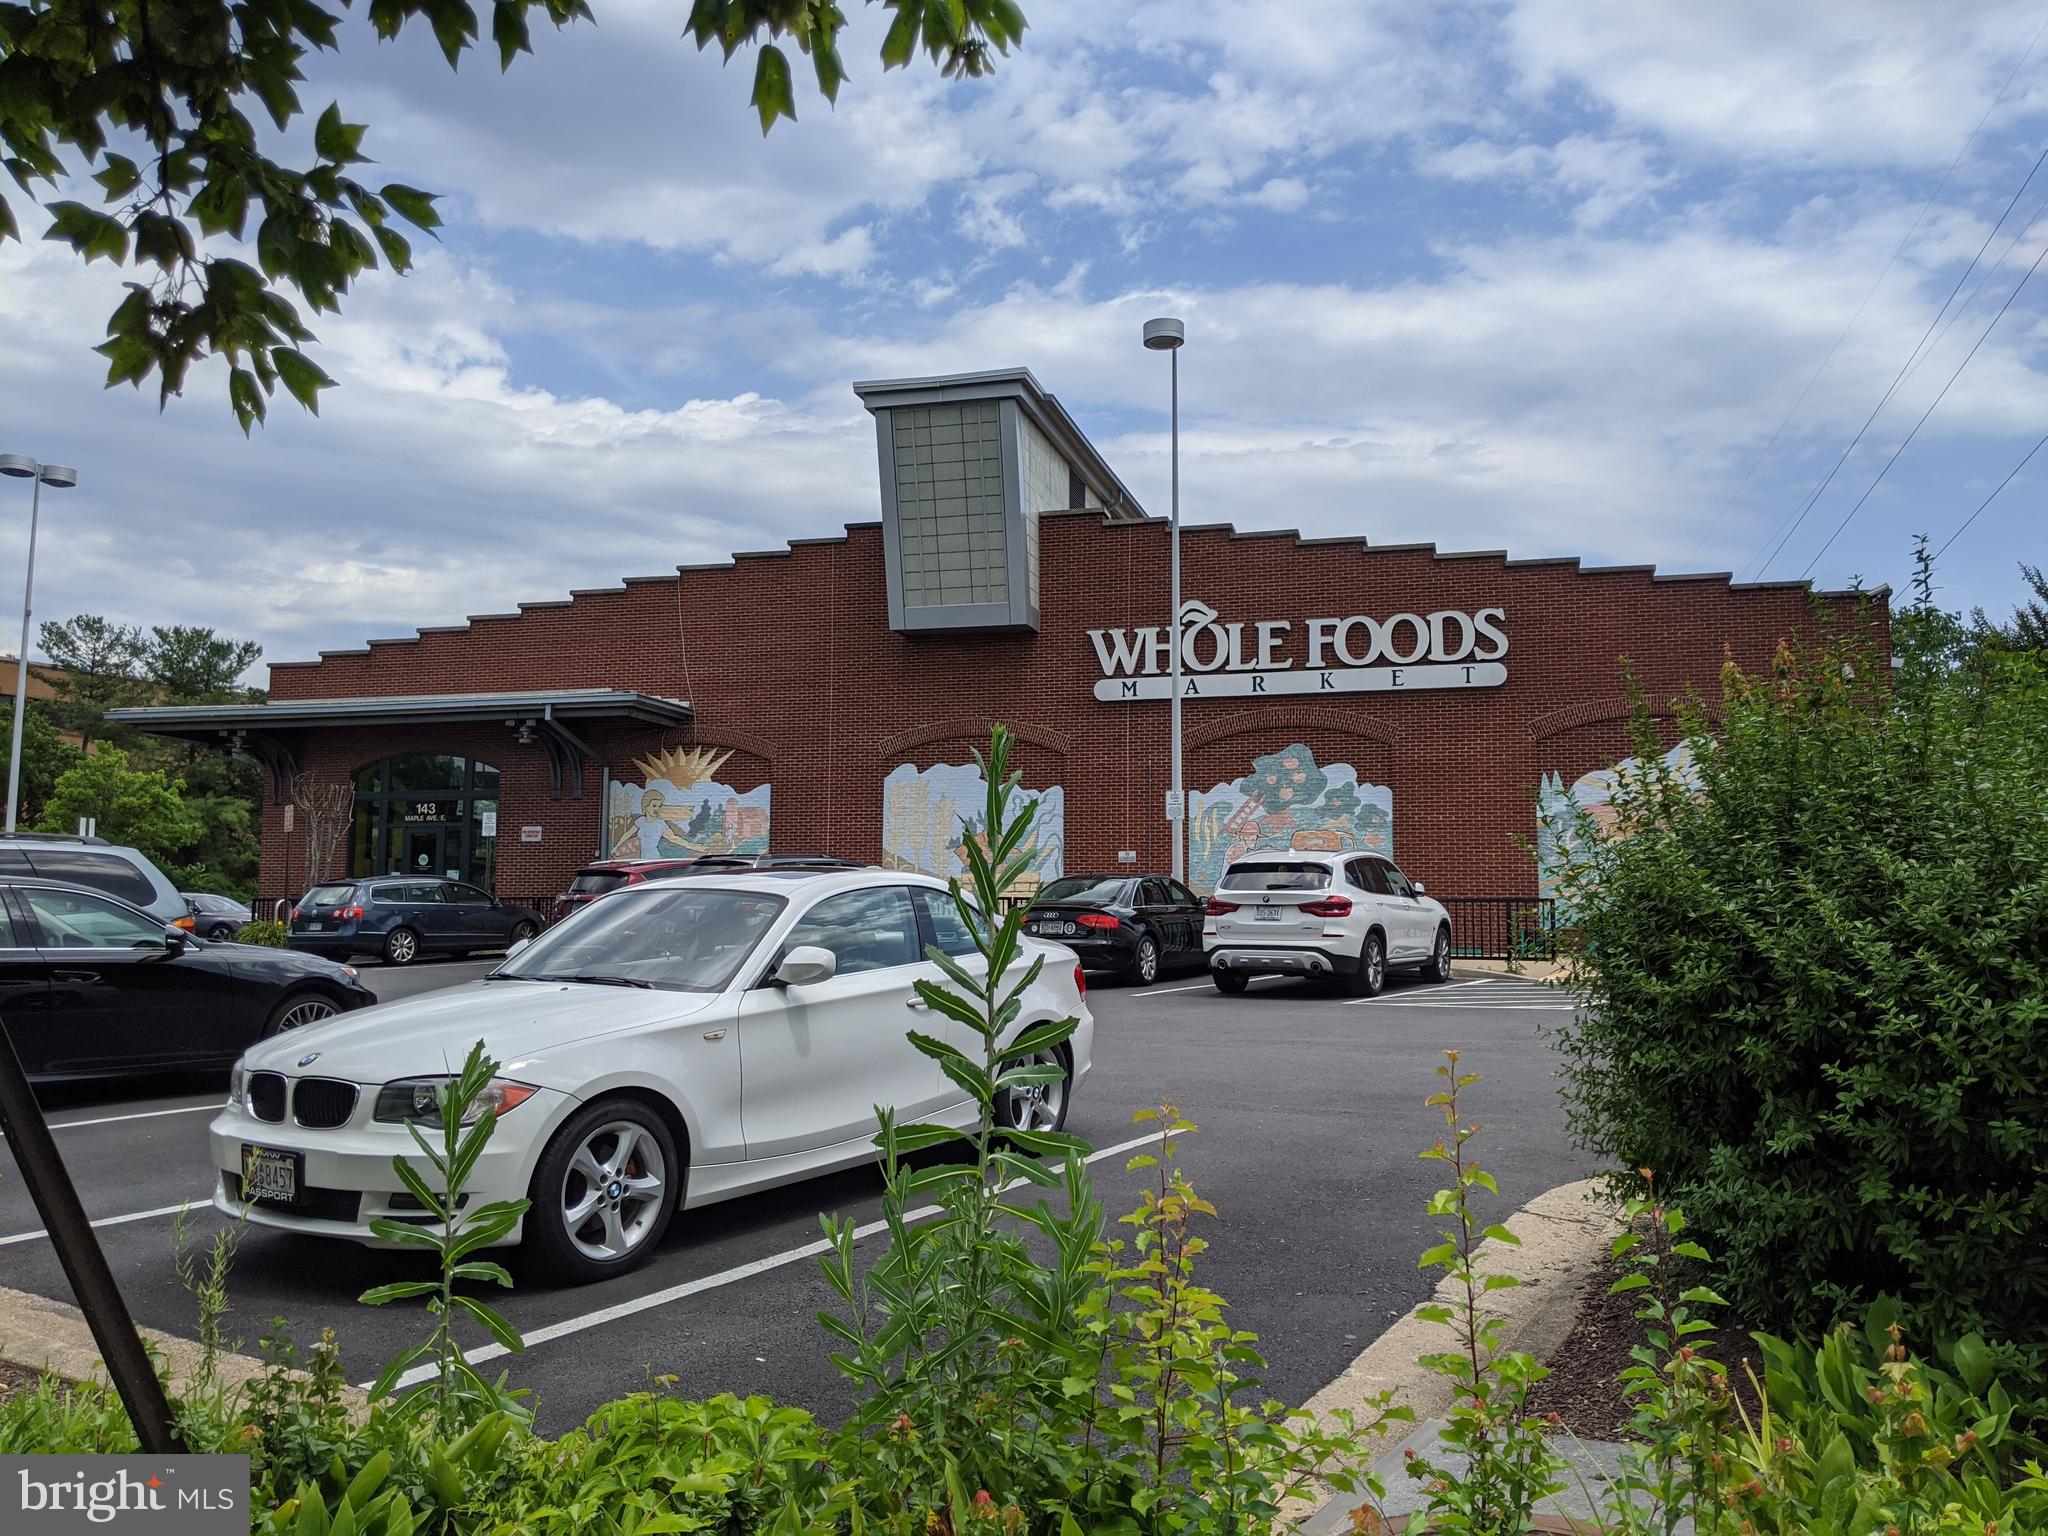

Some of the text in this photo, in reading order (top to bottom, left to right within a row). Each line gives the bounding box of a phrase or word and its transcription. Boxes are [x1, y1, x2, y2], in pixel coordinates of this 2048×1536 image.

[1087, 600, 1509, 676] WHOLE FOODS
[1121, 666, 1475, 698] MARKET
[416, 802, 436, 814] 143
